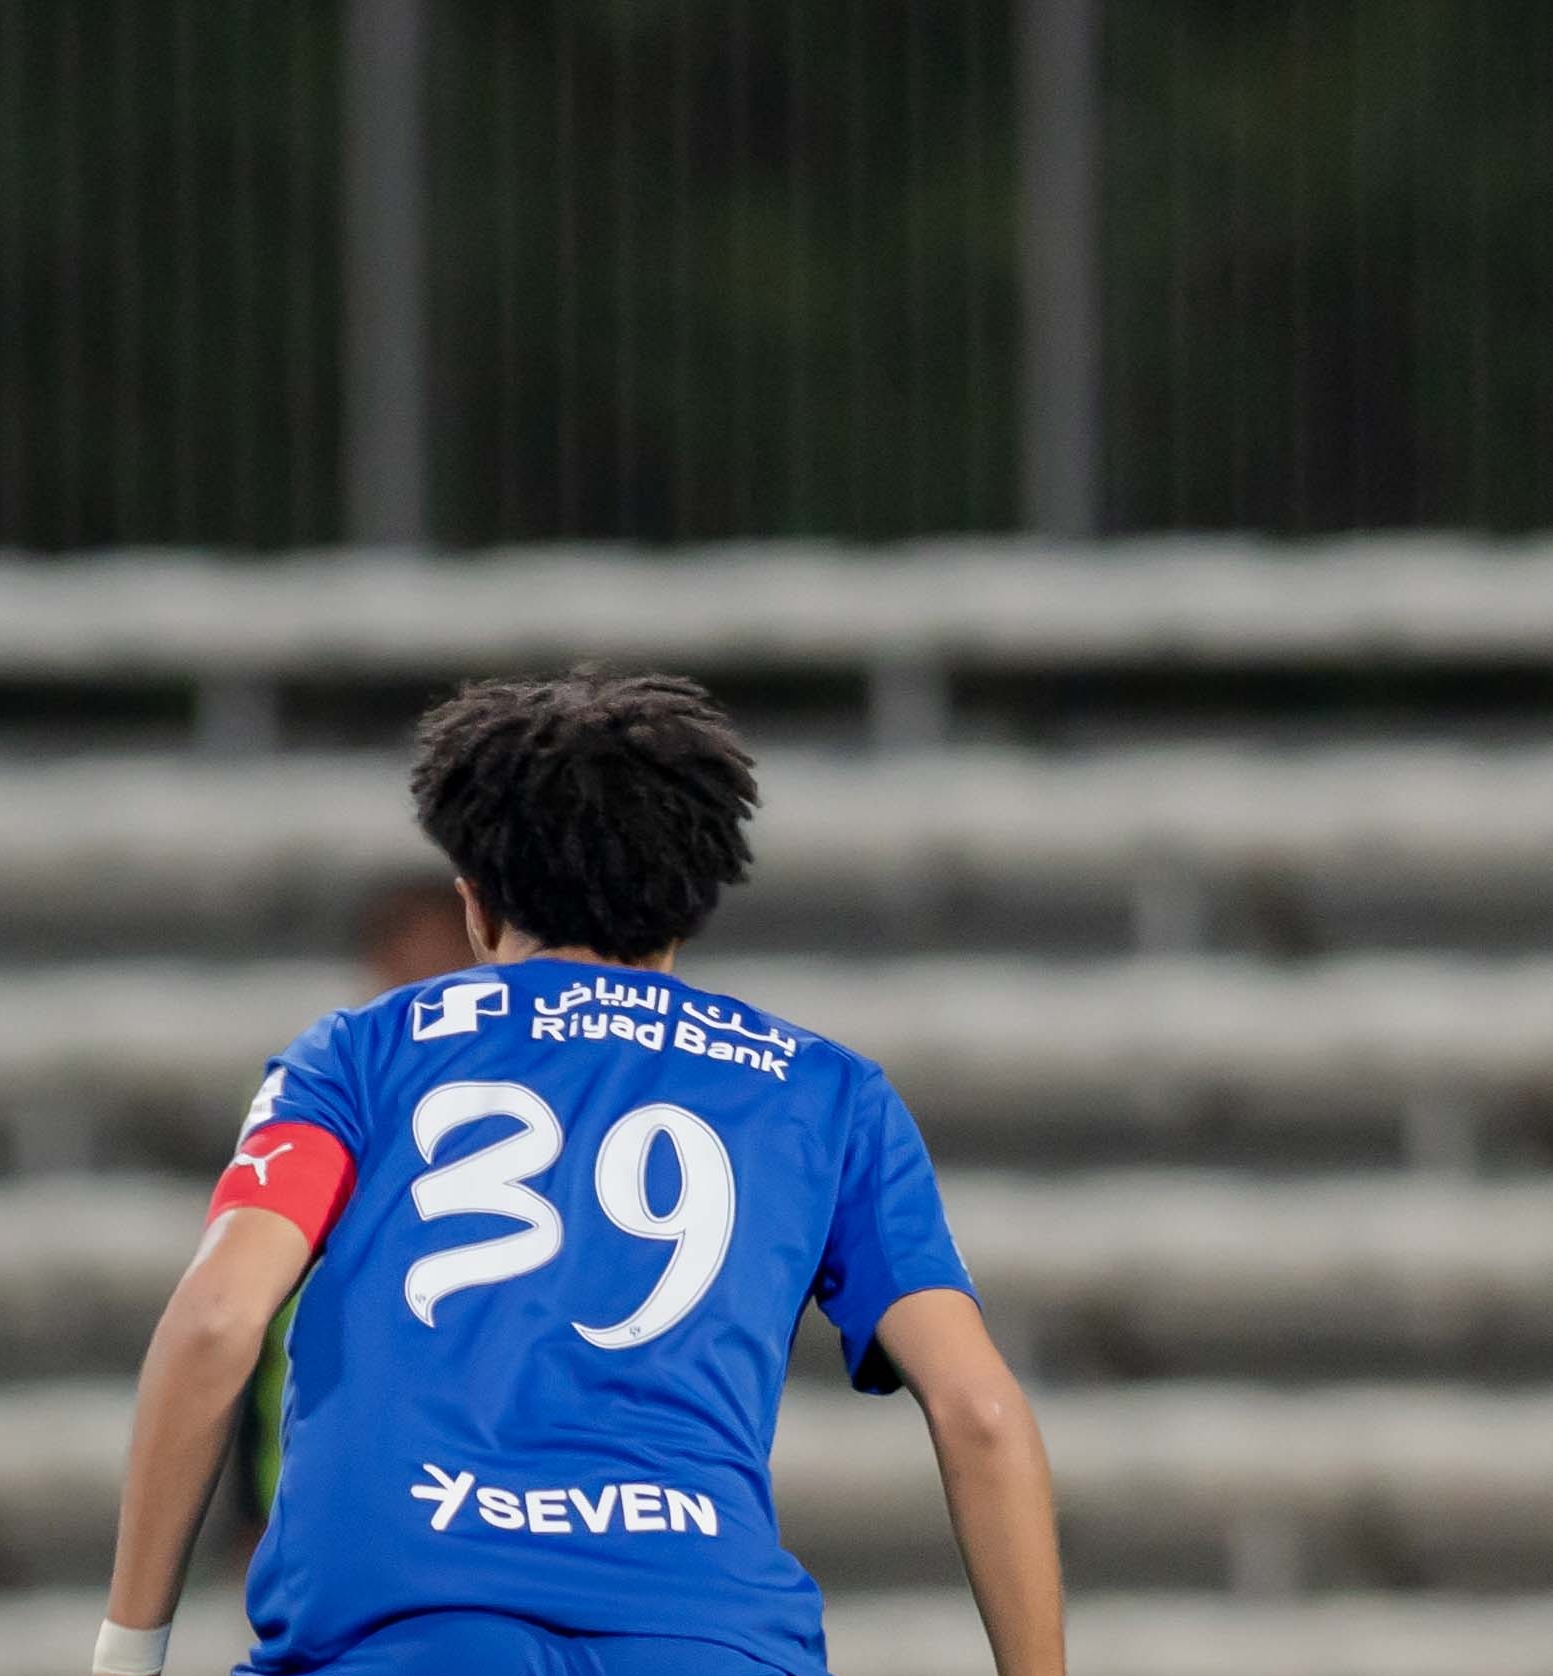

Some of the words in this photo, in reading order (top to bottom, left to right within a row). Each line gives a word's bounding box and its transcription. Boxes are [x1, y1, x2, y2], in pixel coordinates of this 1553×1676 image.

[532, 977, 670, 1016] الرياض
[531, 1013, 666, 1052] Riyad
[673, 1020, 789, 1082] Bank
[682, 998, 796, 1058] بنك
[404, 1081, 736, 1349] 39
[476, 1484, 718, 1536] SEVEN
